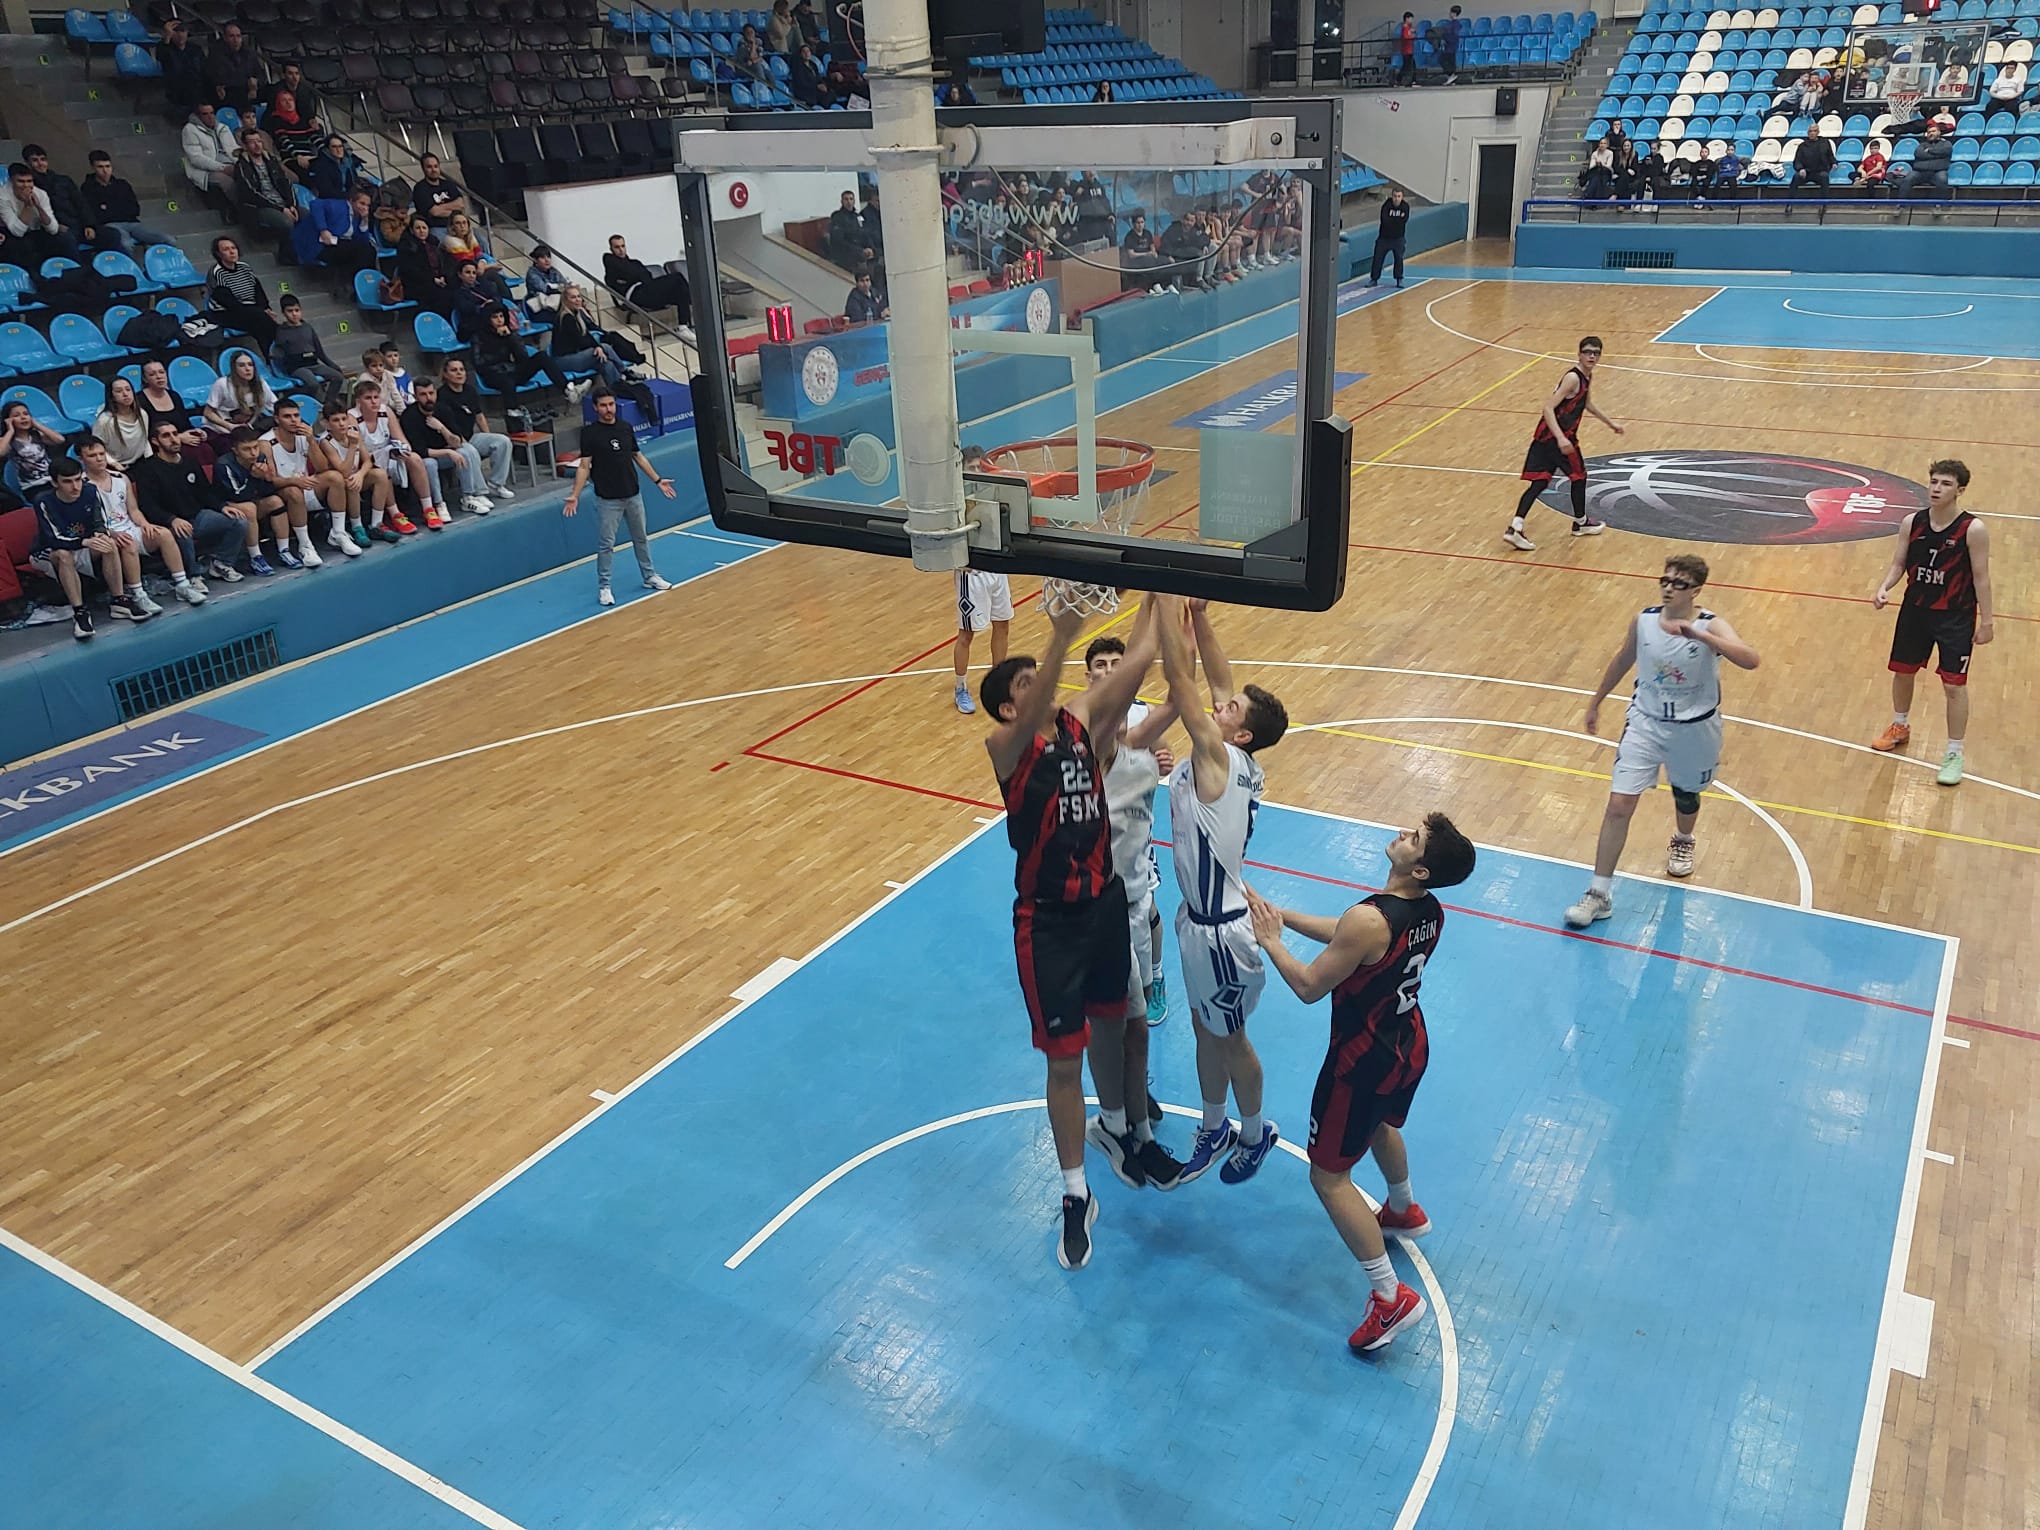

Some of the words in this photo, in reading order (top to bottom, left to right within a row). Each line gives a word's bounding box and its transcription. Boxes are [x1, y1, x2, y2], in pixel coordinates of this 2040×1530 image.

[39, 55, 49, 66] L
[88, 89, 98, 102] K
[135, 122, 144, 135] J
[167, 200, 178, 214] G
[279, 281, 291, 294] E
[338, 322, 349, 333] D
[768, 306, 793, 341] 11
[1929, 549, 1938, 567] 7
[1916, 566, 1945, 585] FSM
[1960, 655, 1970, 674] 7
[1663, 702, 1675, 719] 11
[0, 731, 206, 819] KBANK
[1058, 792, 1100, 824] FSM
[1408, 919, 1438, 951] ÇAĞIN
[1396, 953, 1427, 1016] 2
